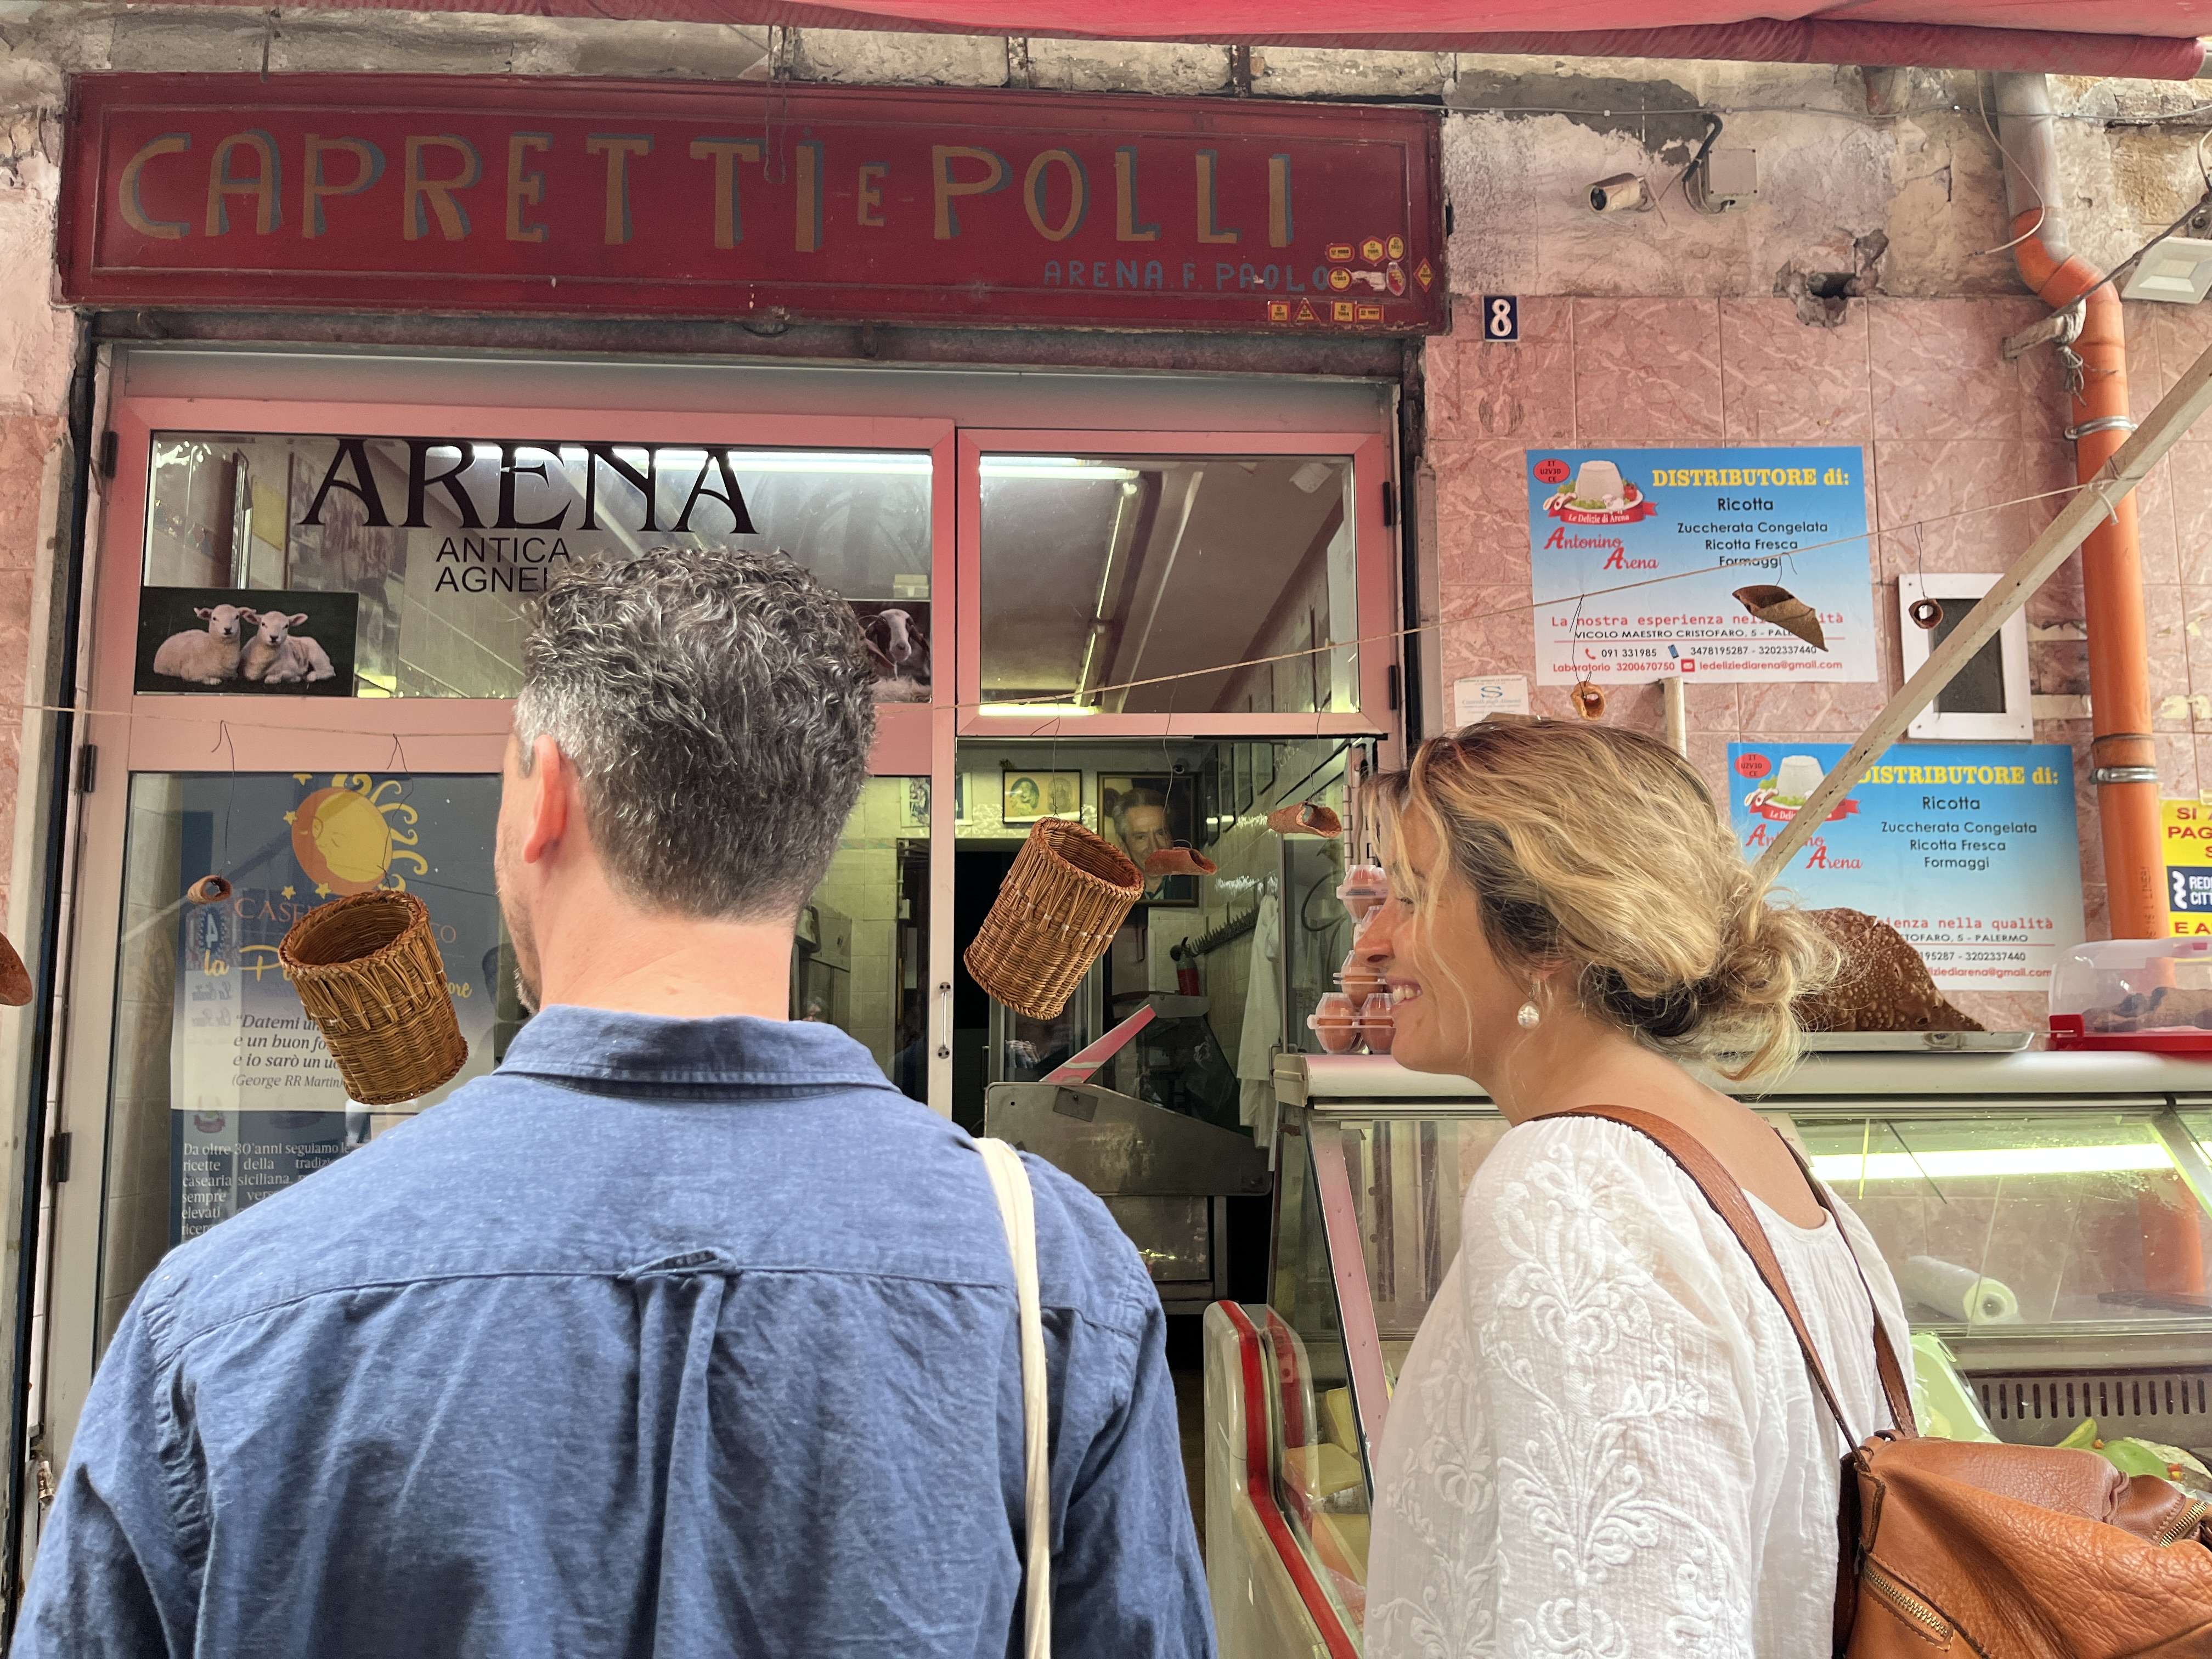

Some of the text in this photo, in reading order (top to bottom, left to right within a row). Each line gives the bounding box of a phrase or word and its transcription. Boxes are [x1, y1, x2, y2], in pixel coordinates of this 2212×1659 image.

[119, 126, 824, 253] CAPRETTI
[931, 143, 1295, 249] POLLI
[1043, 259, 1164, 290] ARENA
[1215, 263, 1329, 292] PAOLO
[1490, 298, 1512, 337] 8
[1652, 468, 1849, 487] DISTRIBUTORE di:
[296, 438, 761, 534] ARENA
[1718, 497, 1774, 511] Ricotta
[1677, 521, 1828, 534] Zuccherata Congelata
[1544, 526, 1624, 549] Antonino
[1705, 539, 1798, 550] Ricotta Fresca
[436, 537, 571, 563] ANTICA
[1603, 547, 1660, 570] Arena
[1719, 555, 1782, 568] Formaggi
[1551, 614, 1767, 628] La nostra esperienza nel
[1575, 630, 1618, 639] VICOLO
[1621, 630, 1673, 639] MAESTRO
[1601, 649, 1618, 657] 091
[1622, 648, 1657, 657] 331985
[1690, 646, 1748, 655] 3478195287
[1758, 645, 1818, 654] 3202337440
[1553, 659, 1843, 672] Laboratorio 3200670750 ledeliziediarena@gmail.com
[2032, 766, 2058, 785] di:
[1922, 796, 1980, 810] Ricotta
[2176, 808, 2197, 820] SI
[1881, 821, 2038, 836] Zuccherata Congelata
[1910, 839, 2006, 851] Ricotta Fresca
[1805, 846, 1863, 869] Arena
[1924, 856, 1990, 871] Formaggi
[2189, 876, 2212, 890] RED
[1938, 917, 1983, 929] nella
[1991, 917, 2054, 931] qualità
[2174, 922, 2189, 934] E
[1975, 934, 2029, 943] PALERMO
[204, 949, 230, 977] la
[1966, 952, 2026, 961] 3202337440
[233, 1035, 243, 1047] e
[247, 1037, 268, 1048] un
[272, 1034, 309, 1049] buon
[233, 1055, 242, 1066] e
[246, 1053, 261, 1067] io
[264, 1054, 300, 1068] sarò
[303, 1057, 320, 1069] un
[284, 1075, 302, 1087] RR
[184, 1143, 199, 1155] Da
[202, 1143, 231, 1155] oltre
[285, 1142, 338, 1157] seguiamo
[183, 1159, 221, 1172] ricette
[243, 1158, 275, 1170] della
[182, 1176, 232, 1187] casearia
[182, 1192, 227, 1206] sempre
[182, 1206, 221, 1219] elevati
